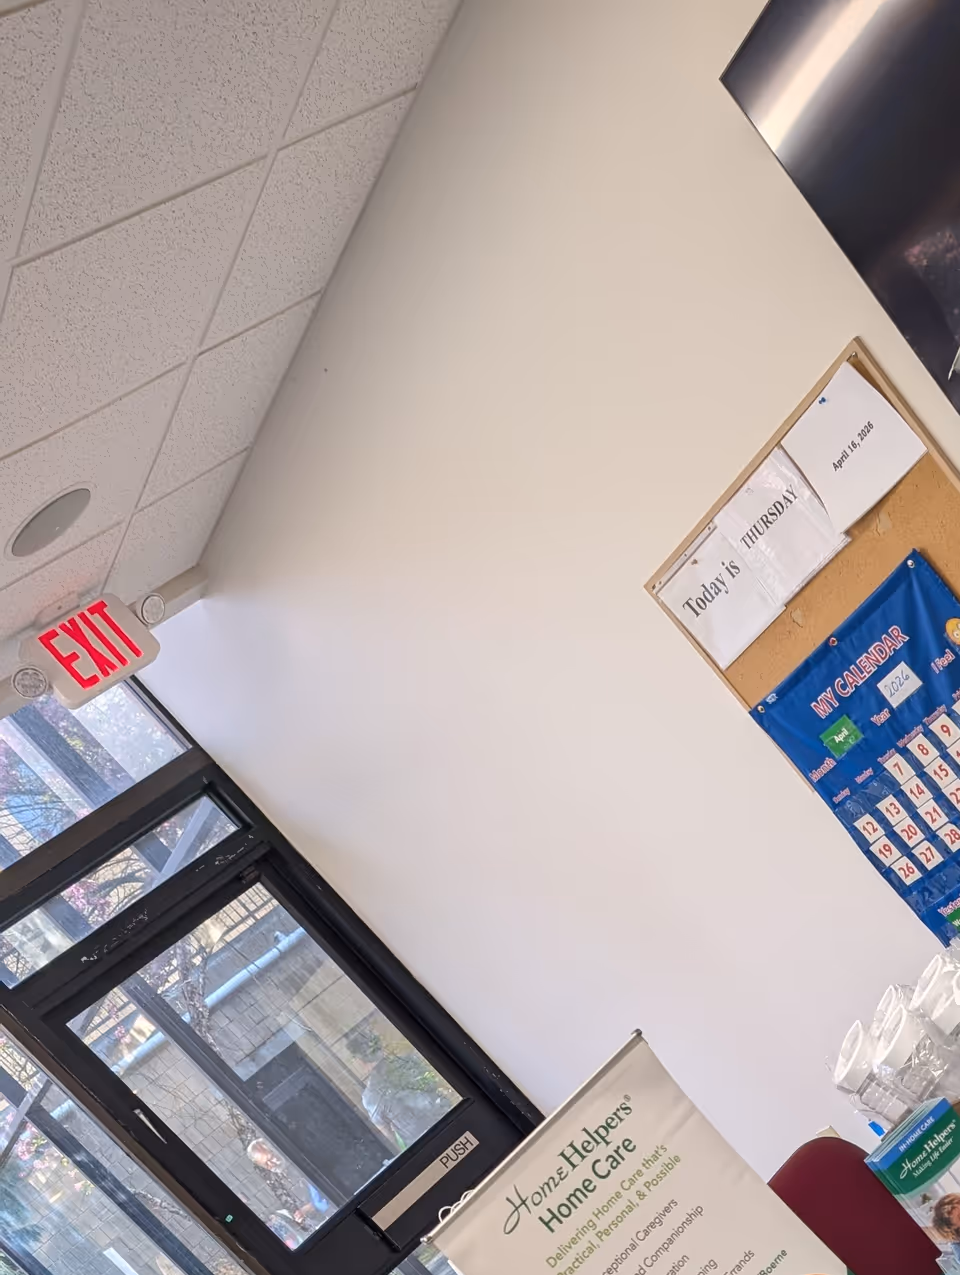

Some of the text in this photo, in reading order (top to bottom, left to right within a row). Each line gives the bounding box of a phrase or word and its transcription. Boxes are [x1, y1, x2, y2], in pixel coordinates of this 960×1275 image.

[832, 421, 874, 471] April 16, 2026
[740, 485, 799, 549] THURSDAY
[683, 559, 741, 617] Today is
[38, 600, 143, 689] EXIT
[935, 649, 955, 671] Feel
[810, 625, 910, 719] MY CALENDAR
[884, 669, 910, 698] 2026
[833, 728, 849, 743] April
[871, 708, 891, 726] Year
[809, 757, 837, 783] Month
[893, 762, 904, 775] 7
[917, 743, 929, 756] 8
[941, 724, 951, 737] 9
[863, 820, 878, 836] 12
[885, 801, 900, 818] 13
[909, 783, 925, 799] 14
[933, 764, 949, 780] 15
[879, 843, 894, 859] 19
[901, 823, 918, 841] 20
[925, 807, 943, 824] 21
[898, 861, 916, 878] 26
[920, 846, 937, 864] 27
[944, 828, 960, 846] 28
[440, 1136, 473, 1169] PUSH
[899, 1116, 935, 1152] IN-HOME CARE
[538, 1137, 636, 1234] Home Care
[900, 1150, 927, 1179] Home
[913, 1161, 932, 1178] Making
[930, 1150, 940, 1162] Life
[503, 1166, 569, 1235] Home
[546, 1144, 668, 1268] Delivering Home Care that's
[595, 1200, 639, 1242] Personal,
[636, 1190, 647, 1201] &
[644, 1154, 681, 1192] Possible
[636, 1199, 678, 1242] Caregivers
[643, 1205, 704, 1268] Companionship
